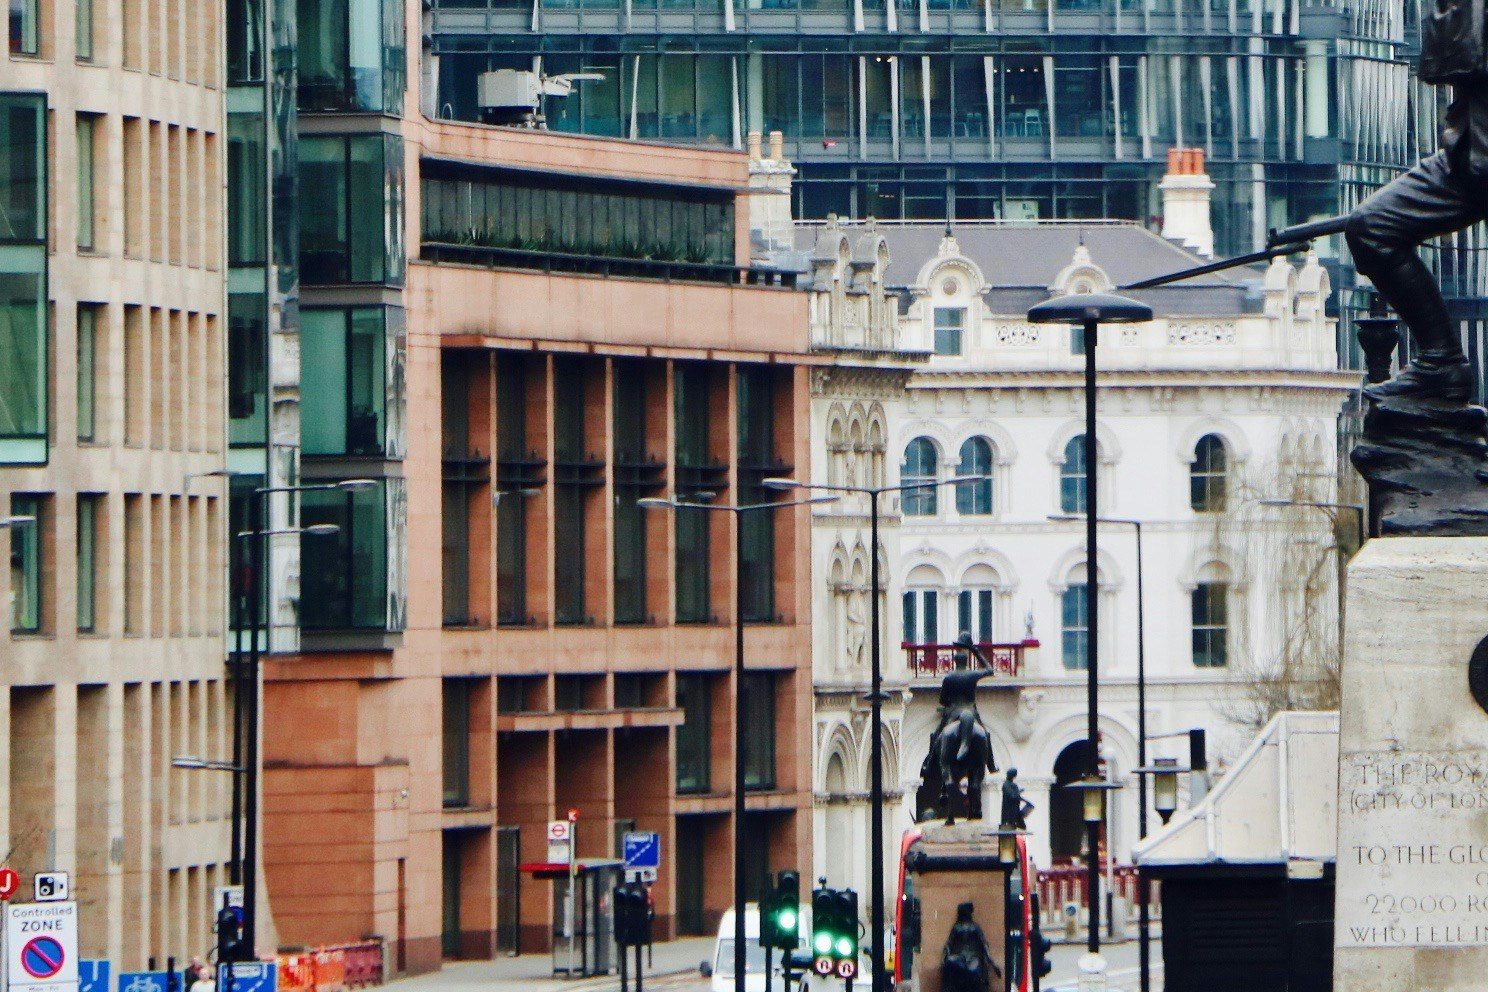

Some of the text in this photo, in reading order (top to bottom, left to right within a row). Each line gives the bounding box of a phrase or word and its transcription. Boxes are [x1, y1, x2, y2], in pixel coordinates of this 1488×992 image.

[1355, 763, 1412, 785] THE
[1410, 792, 1442, 809] OF
[1352, 846, 1387, 865] TO
[1392, 845, 1441, 865] THE
[0, 872, 12, 894] J
[12, 906, 73, 919] Controlled
[1365, 893, 1457, 915] 22000
[21, 919, 64, 932] ZONE
[1350, 926, 1406, 943] WHO
[1415, 926, 1464, 943] FELL
